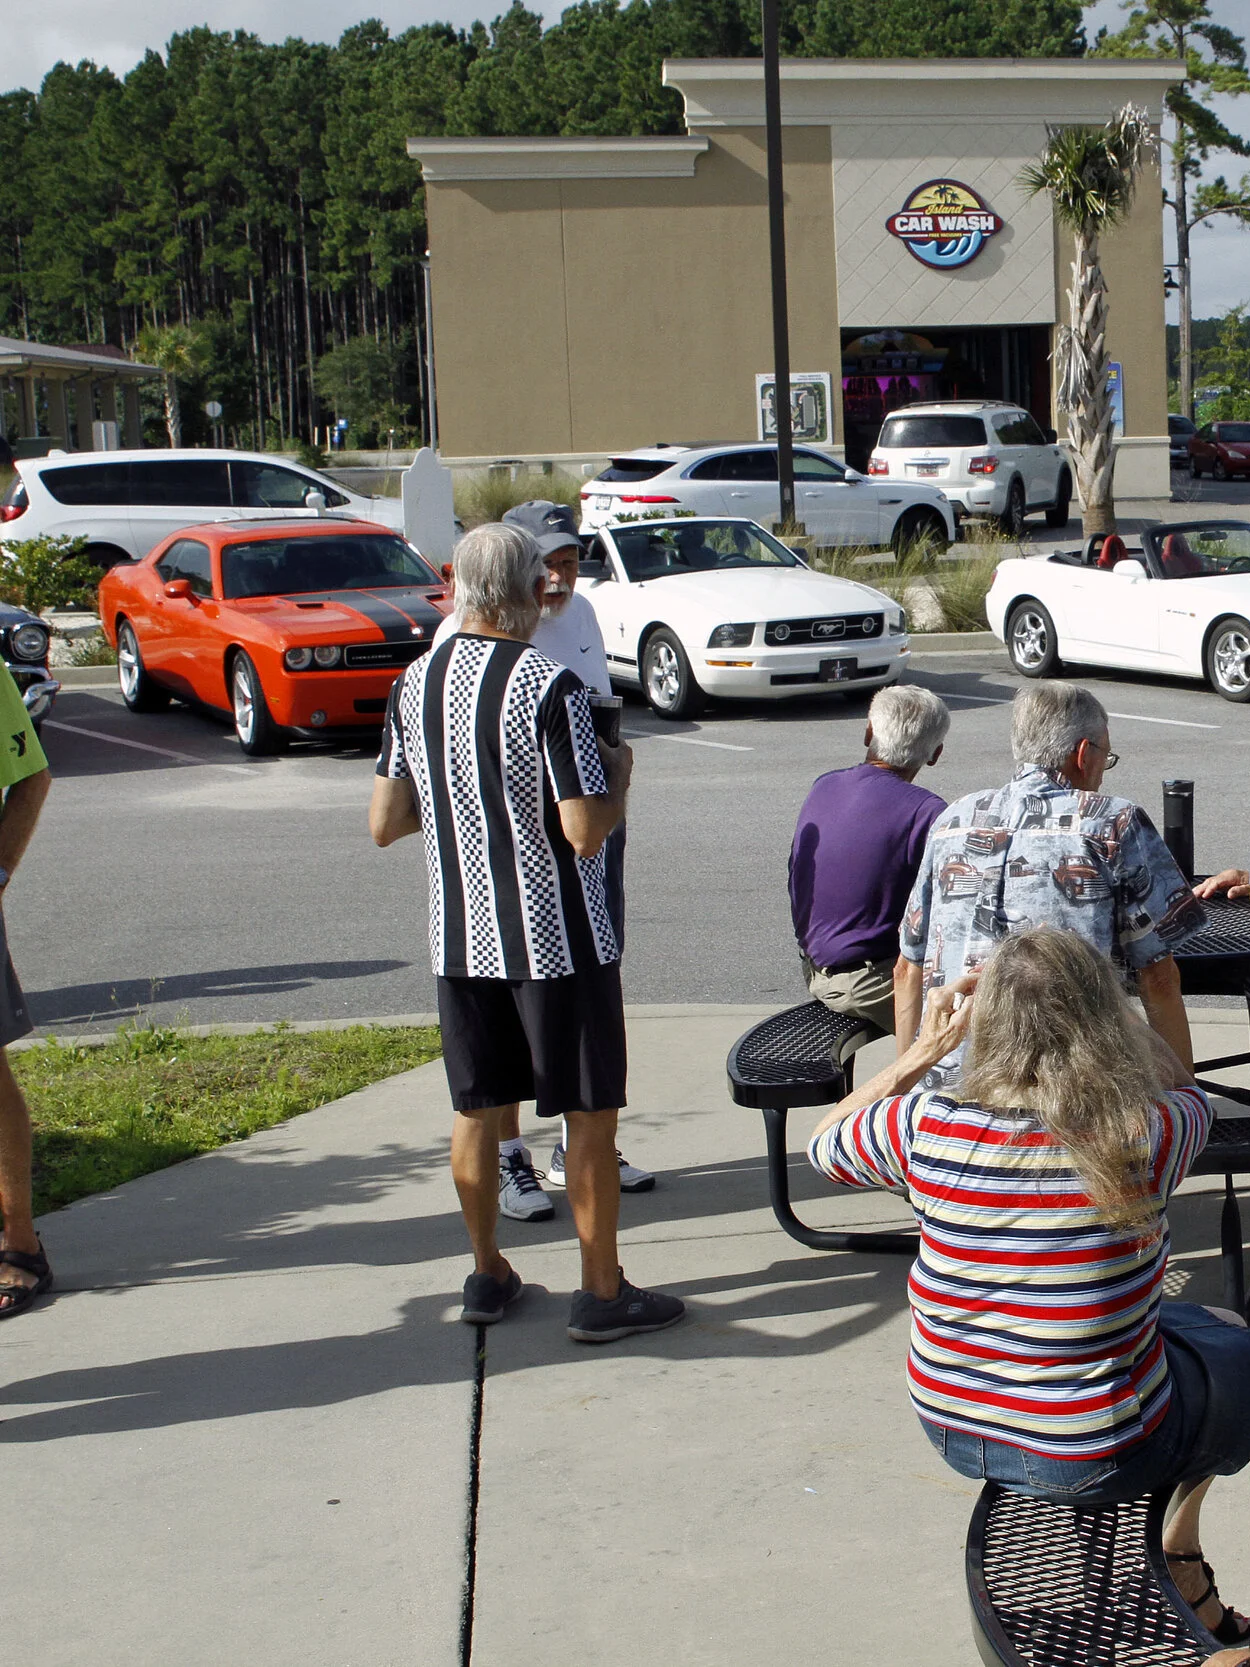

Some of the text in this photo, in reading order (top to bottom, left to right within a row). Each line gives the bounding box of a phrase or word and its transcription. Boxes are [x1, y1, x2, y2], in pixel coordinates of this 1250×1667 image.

[925, 204, 964, 215] Island
[895, 216, 994, 231] CAR WASH
